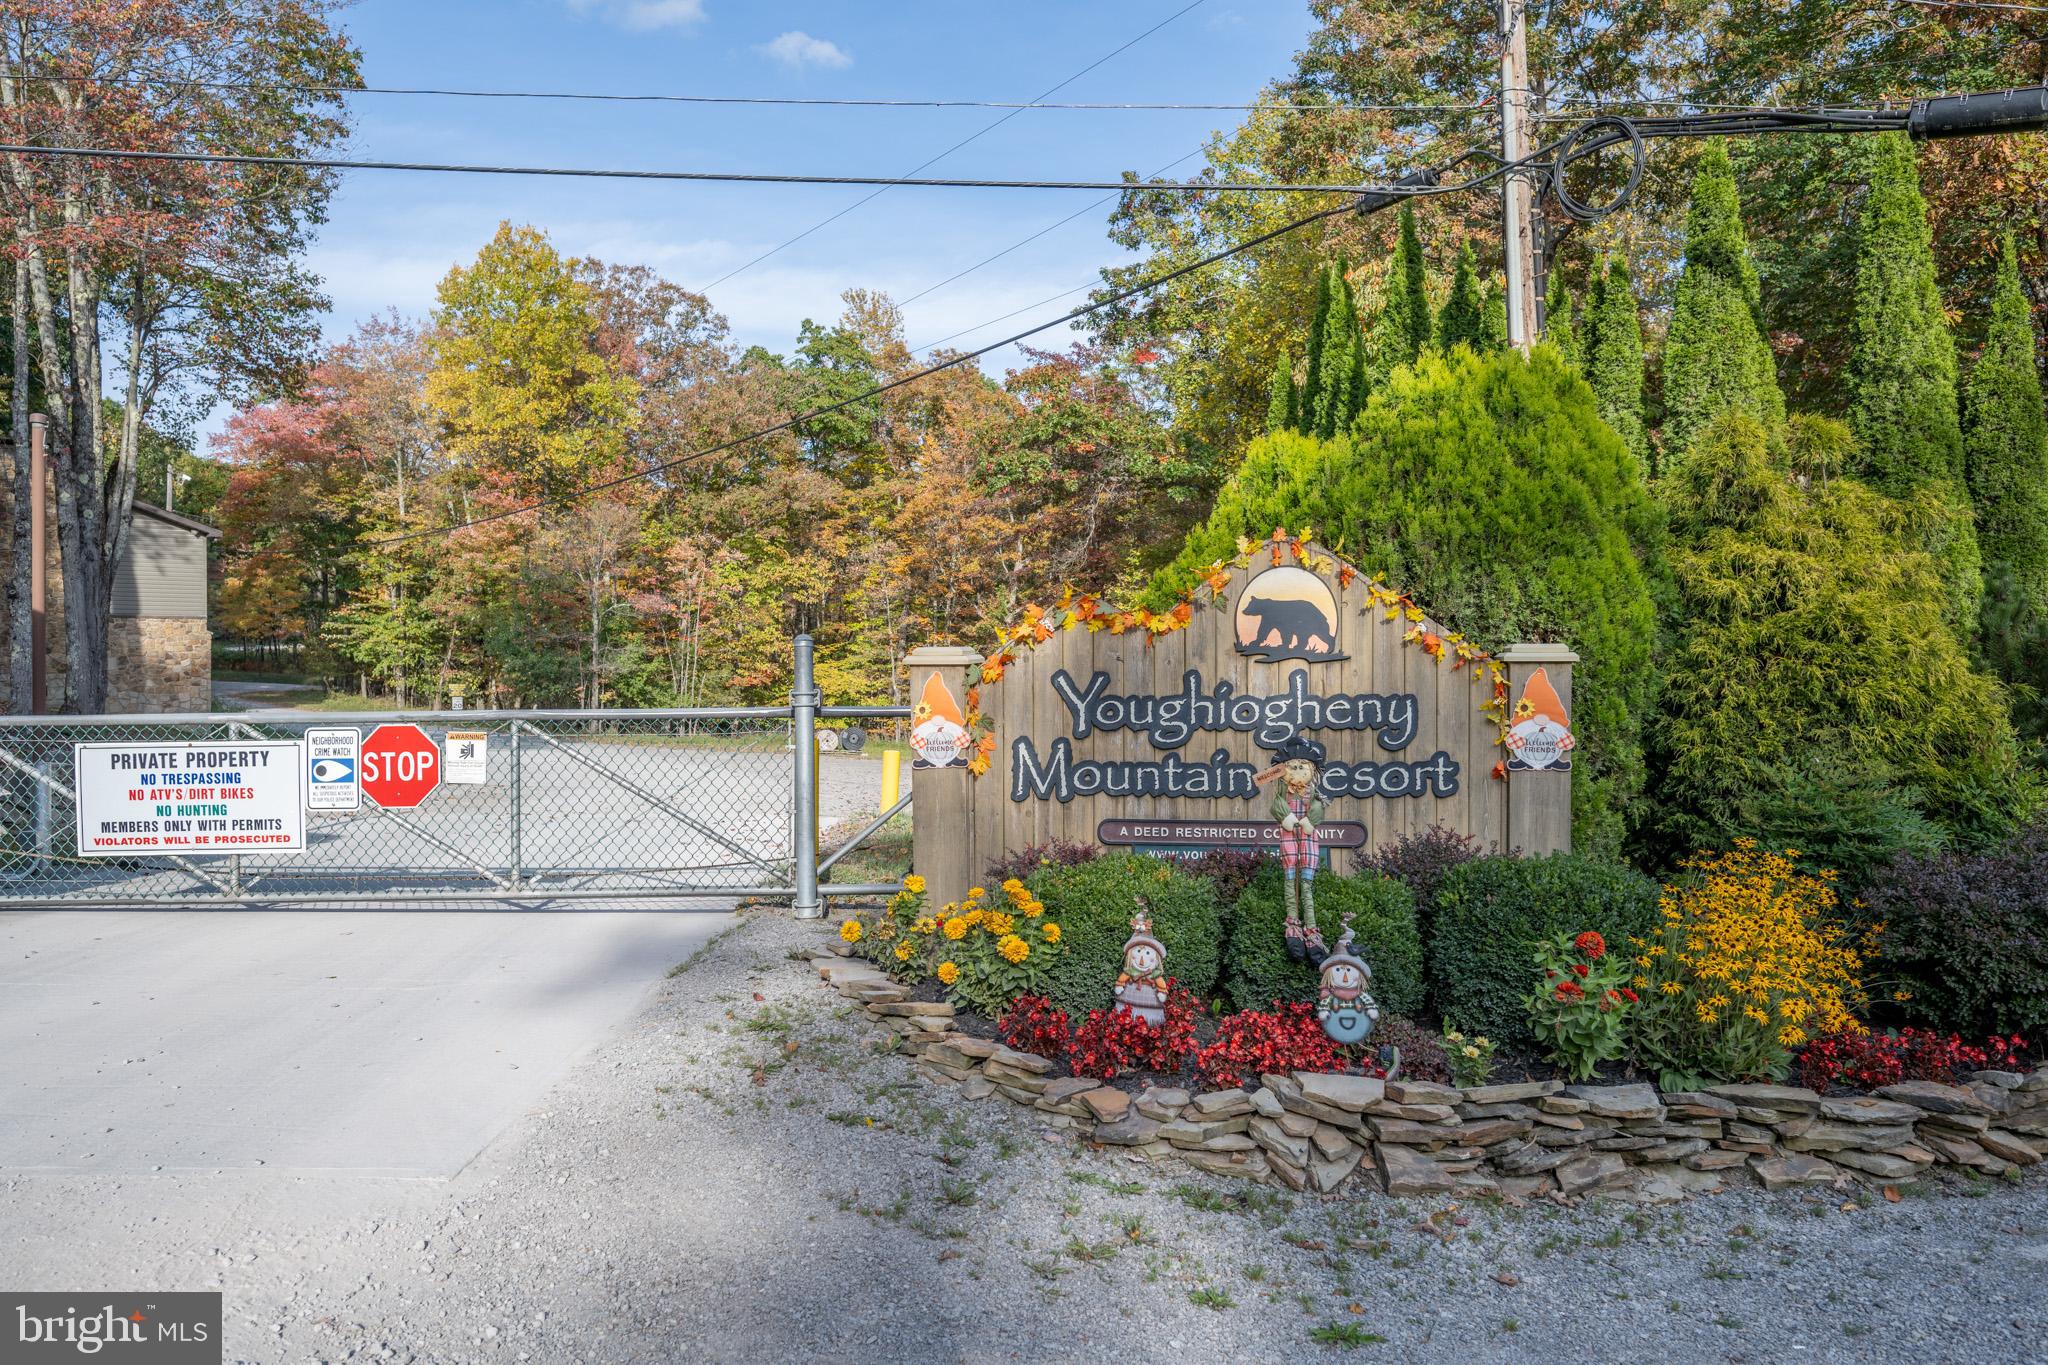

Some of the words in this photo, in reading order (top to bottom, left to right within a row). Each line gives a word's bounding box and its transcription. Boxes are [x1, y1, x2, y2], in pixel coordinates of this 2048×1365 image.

[1055, 672, 1414, 747] Youghiogheny
[312, 736, 354, 745] NEIGHBORHOOD
[314, 748, 331, 756] CRIME
[332, 748, 351, 756] WATCH
[111, 753, 178, 770] PRIVATE
[186, 751, 270, 769] PROPERTY
[362, 751, 434, 782] STOP
[1014, 741, 1254, 800] Mountain
[1321, 755, 1455, 794] esort
[140, 774, 157, 785] NO
[162, 773, 241, 785] TRESPASSING
[129, 789, 145, 801] NO
[150, 788, 215, 800] ATV'S/DIRT
[221, 787, 254, 799] BIKES
[156, 805, 172, 817] NO
[178, 804, 228, 816] HUNTING
[101, 820, 159, 833] MEMBERS
[164, 820, 192, 832] ONLY
[198, 819, 227, 831] WITH
[232, 818, 282, 831] PERMITS
[1119, 826, 1128, 836] A
[1134, 827, 1169, 837] DEED
[1175, 828, 1257, 839] RESTRICTED
[1263, 828, 1345, 839] CONITY
[94, 837, 159, 846] VIOLATORS
[164, 836, 191, 845] WILL
[195, 836, 210, 844] BE
[214, 835, 291, 844] PROSECUTED
